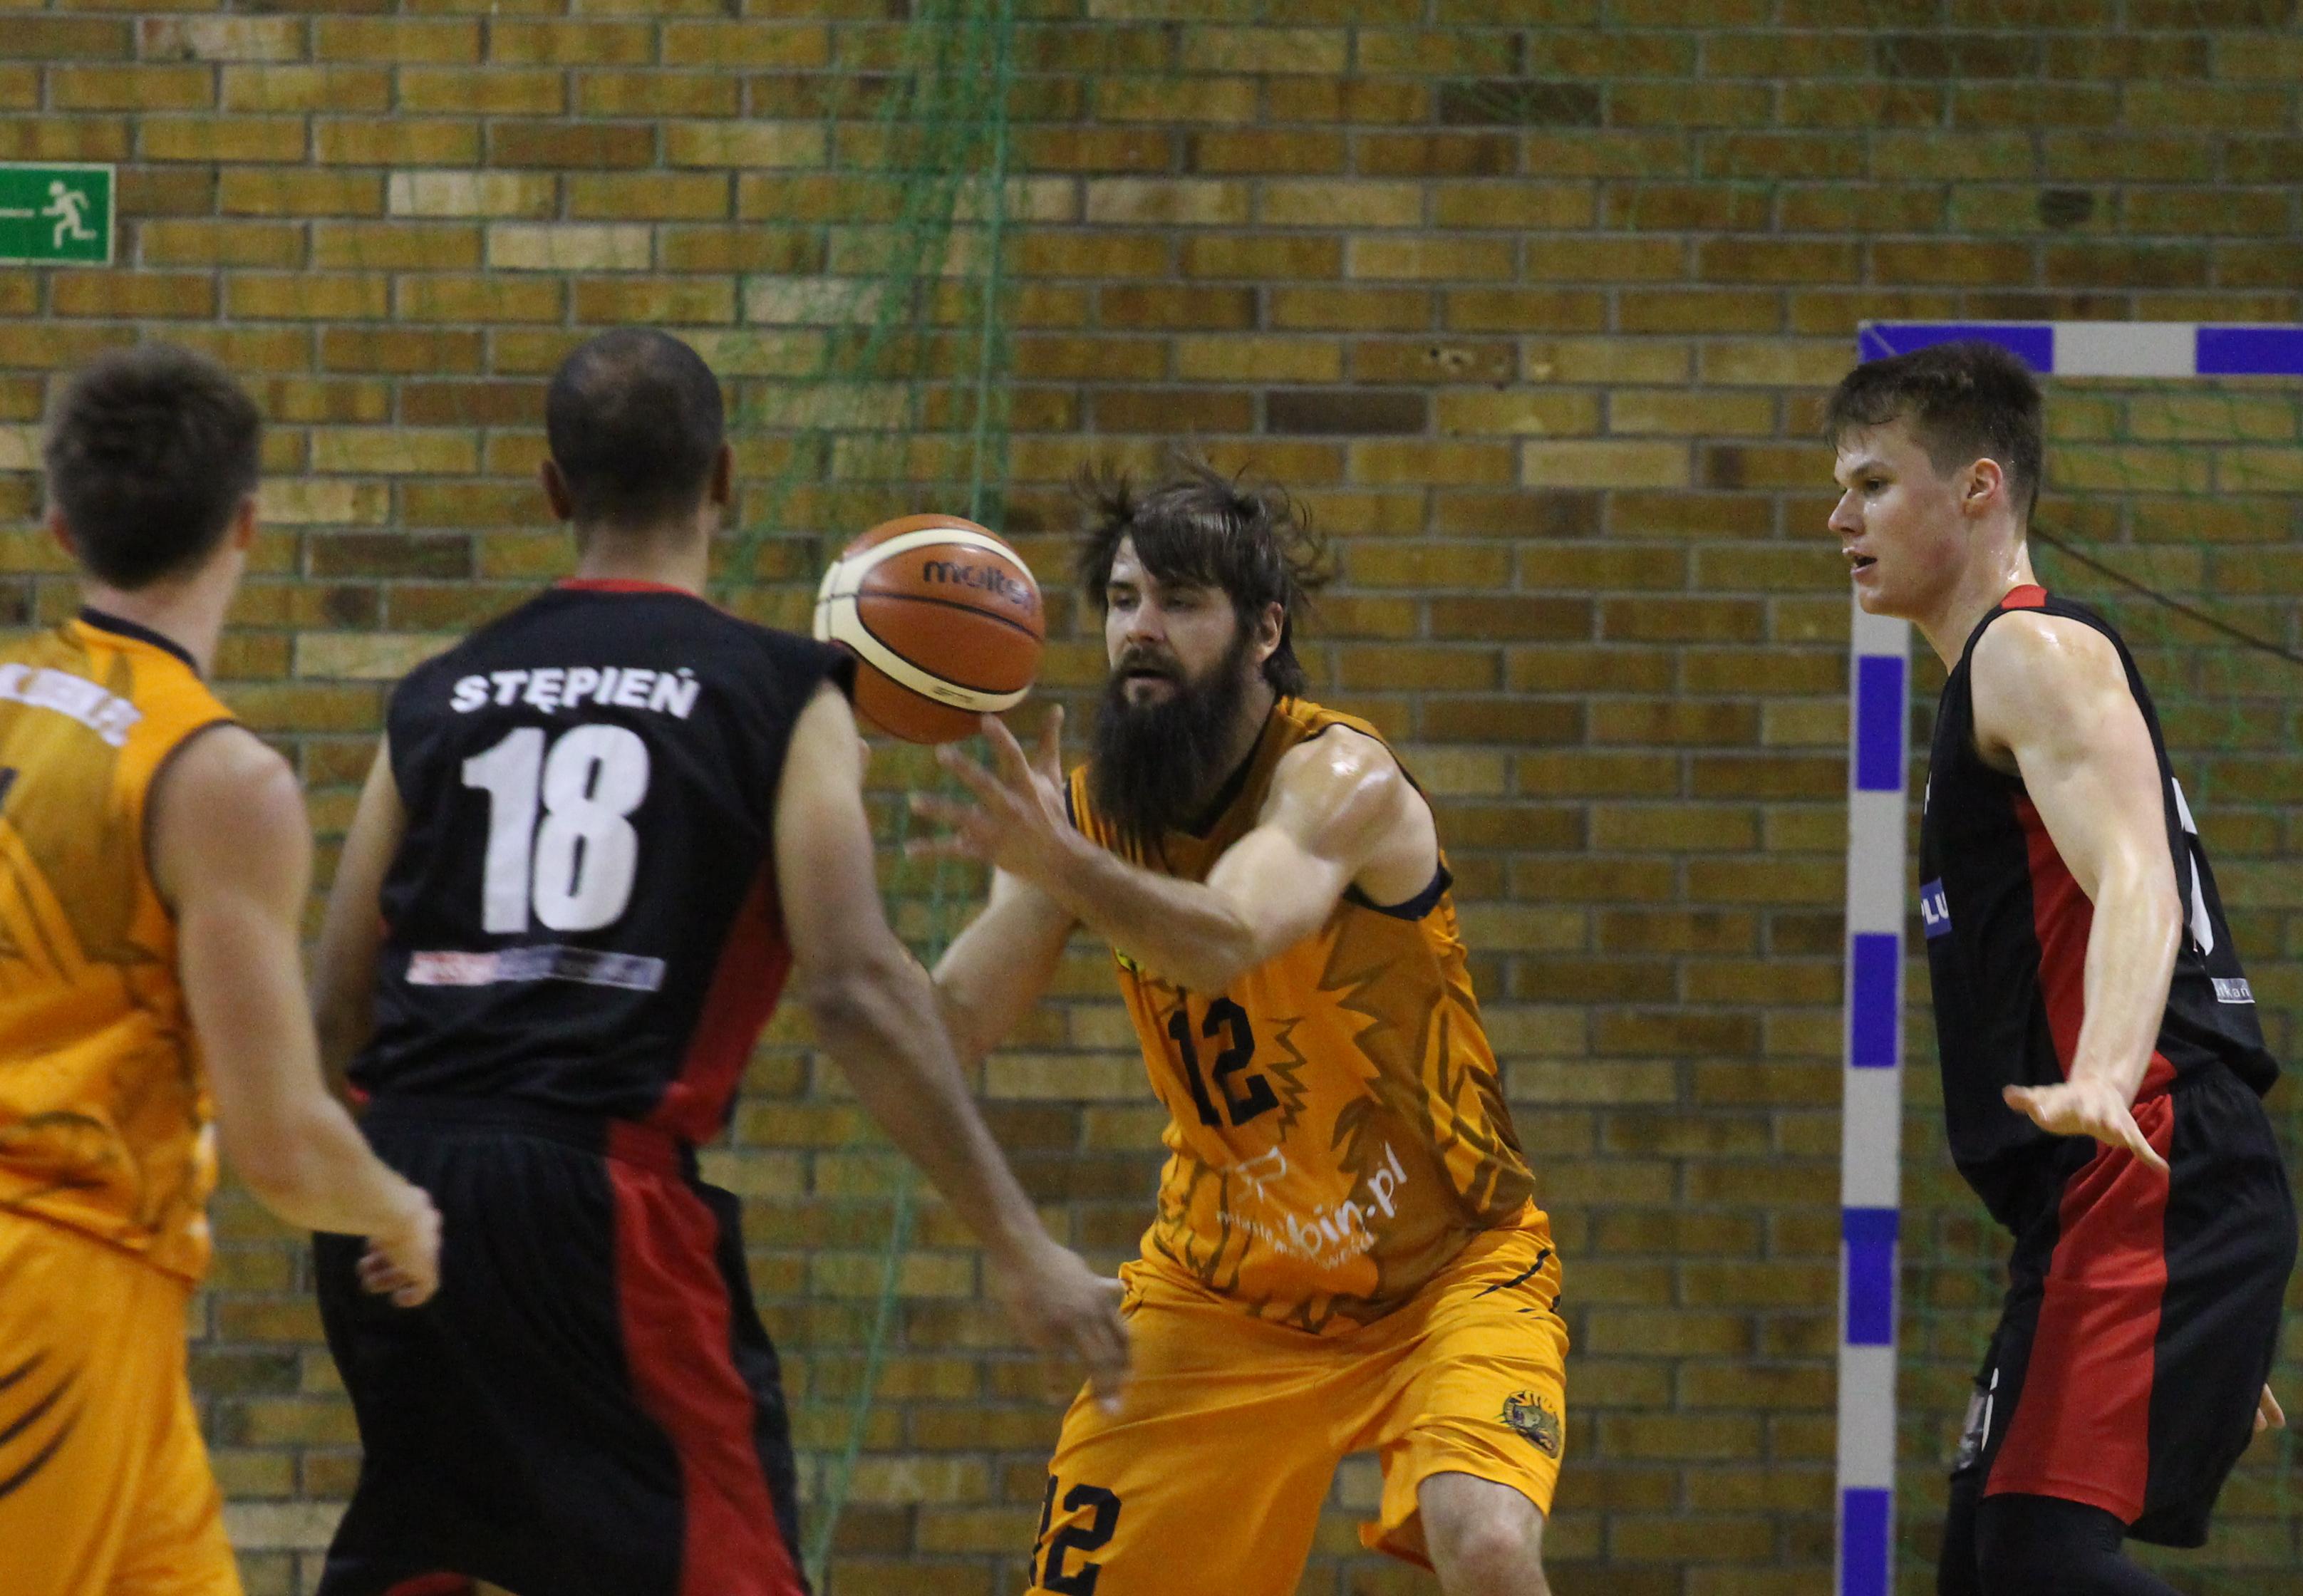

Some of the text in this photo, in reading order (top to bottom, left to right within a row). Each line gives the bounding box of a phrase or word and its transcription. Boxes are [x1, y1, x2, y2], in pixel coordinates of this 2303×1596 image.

[450, 667, 700, 720] STĘPIEŃ
[461, 723, 651, 935] 18
[1167, 996, 1280, 1127] 12
